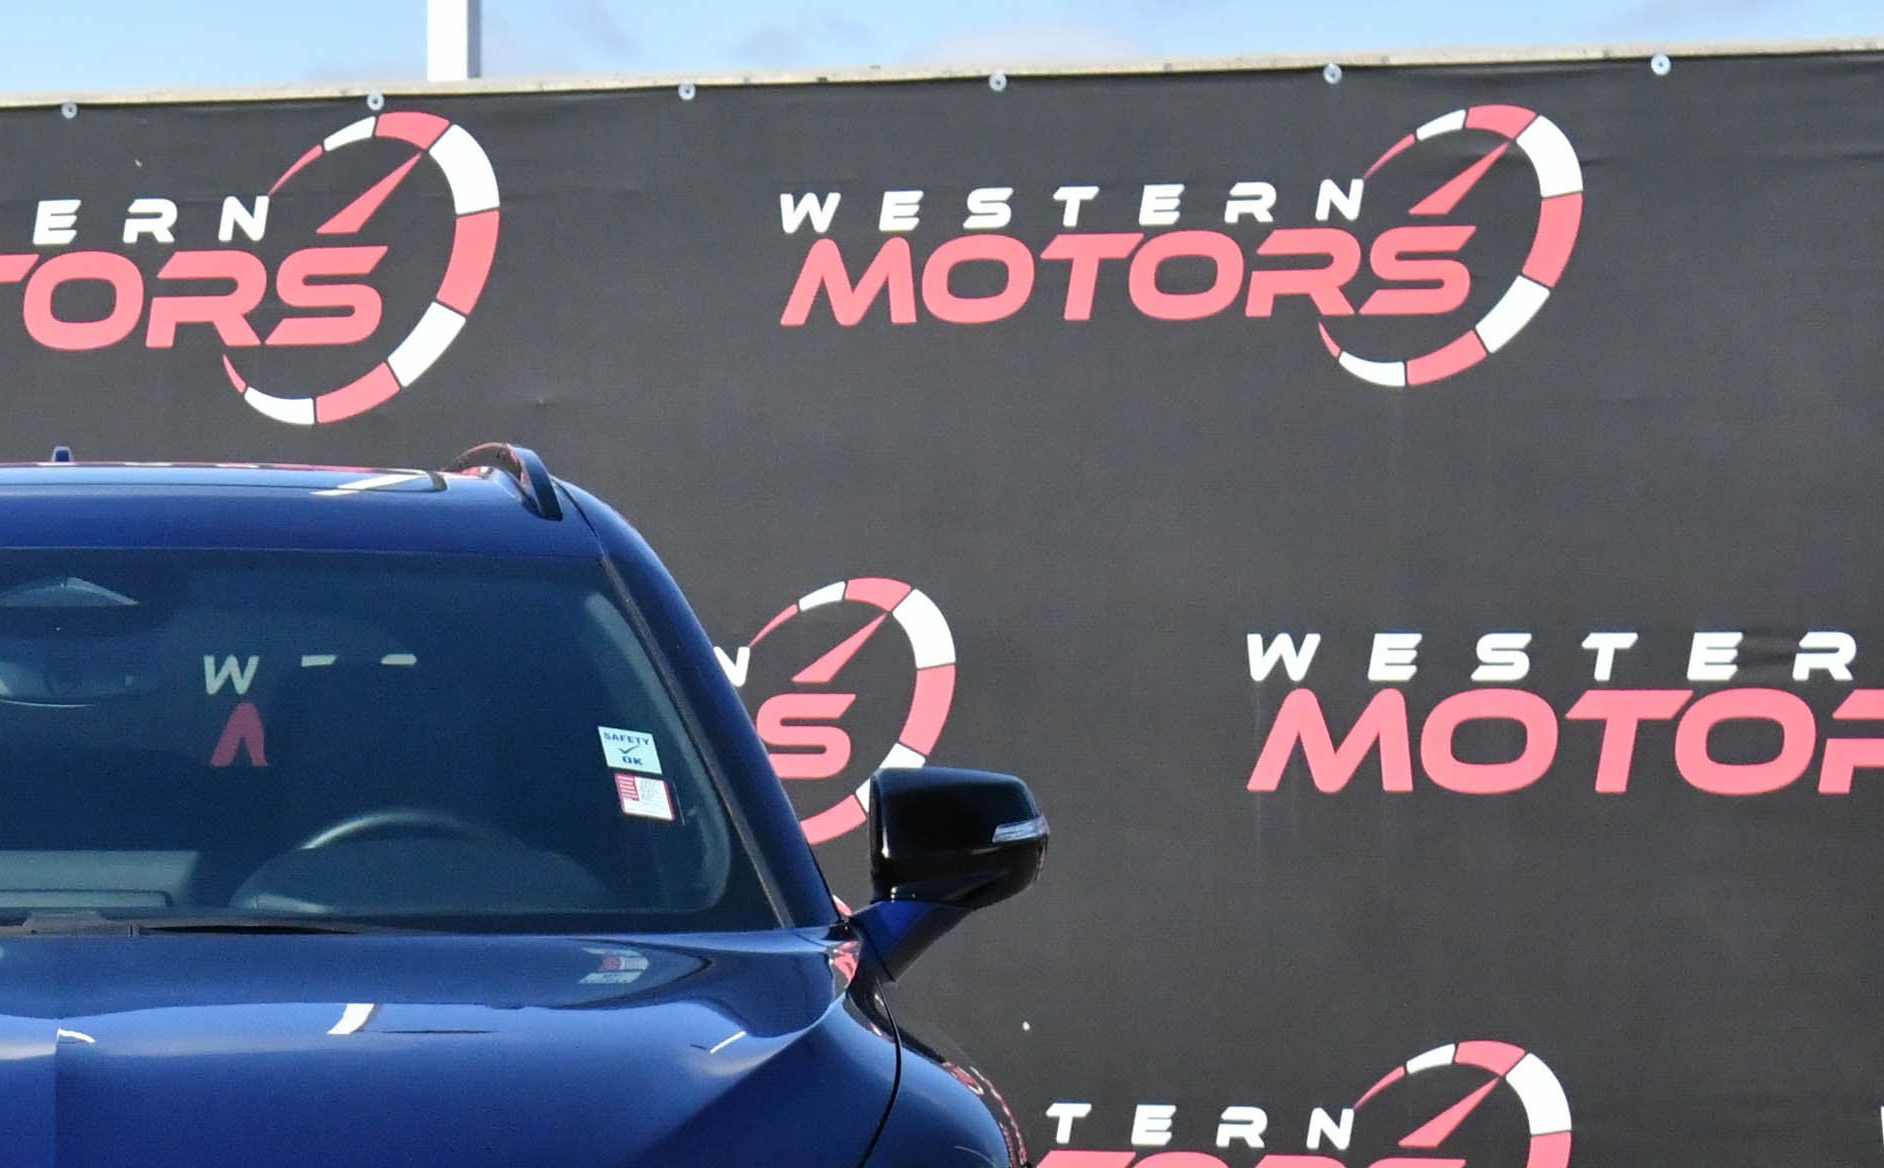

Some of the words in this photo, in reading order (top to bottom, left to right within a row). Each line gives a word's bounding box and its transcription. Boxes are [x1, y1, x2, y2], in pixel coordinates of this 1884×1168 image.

[779, 178, 1365, 234] WESTERN
[780, 225, 1477, 327] MOTORS
[603, 732, 649, 745] SAFETY
[622, 756, 643, 766] OK
